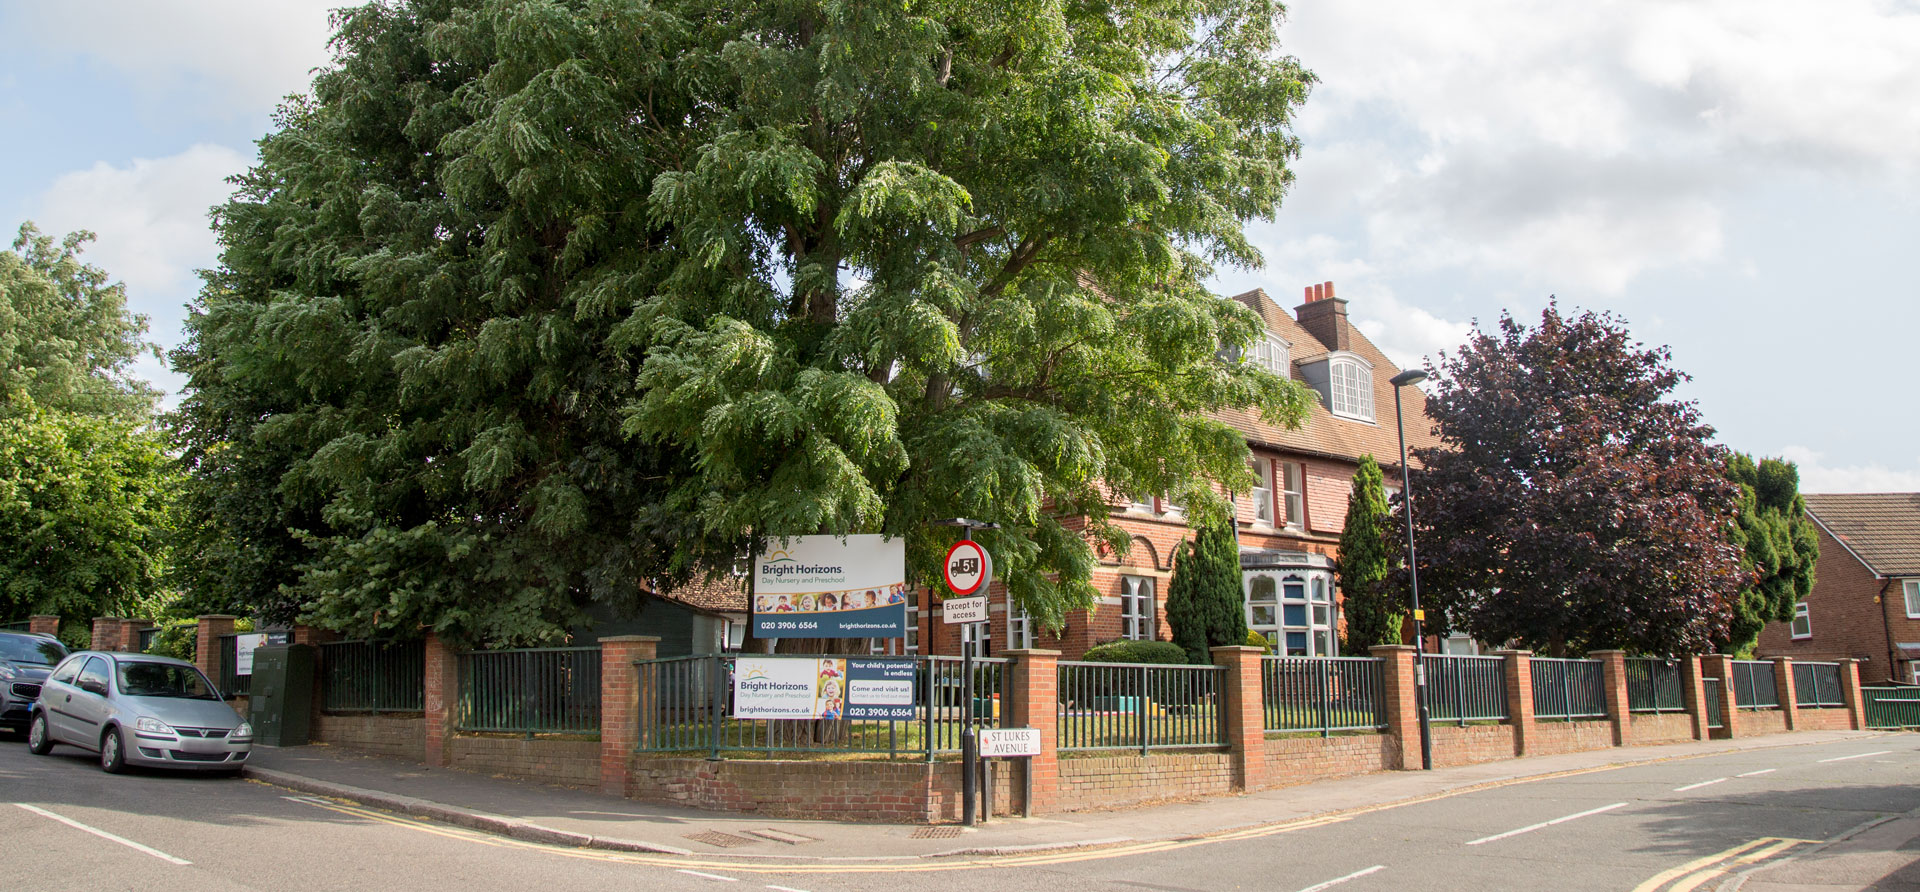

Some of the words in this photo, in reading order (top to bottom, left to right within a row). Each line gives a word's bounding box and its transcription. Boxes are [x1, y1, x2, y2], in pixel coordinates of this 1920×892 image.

[762, 564, 794, 577] Bright
[796, 564, 842, 574] Horizons
[762, 577, 775, 585] Day
[776, 577, 800, 585] Nursery
[815, 576, 845, 584] Preschool
[946, 602, 970, 611] Except
[952, 611, 976, 619] access
[839, 622, 897, 631] brighthorizons.co.uk
[886, 662, 913, 670] potential
[740, 681, 767, 692] Bright
[769, 682, 809, 691] Horizons
[739, 706, 810, 714] brighthorizons.co.uk
[849, 707, 866, 716] 020
[867, 708, 889, 716] 3906
[890, 708, 912, 717] 6564
[991, 732, 1002, 742] ST
[1004, 731, 1030, 742] LUKES
[993, 743, 1028, 753] AVENUE
